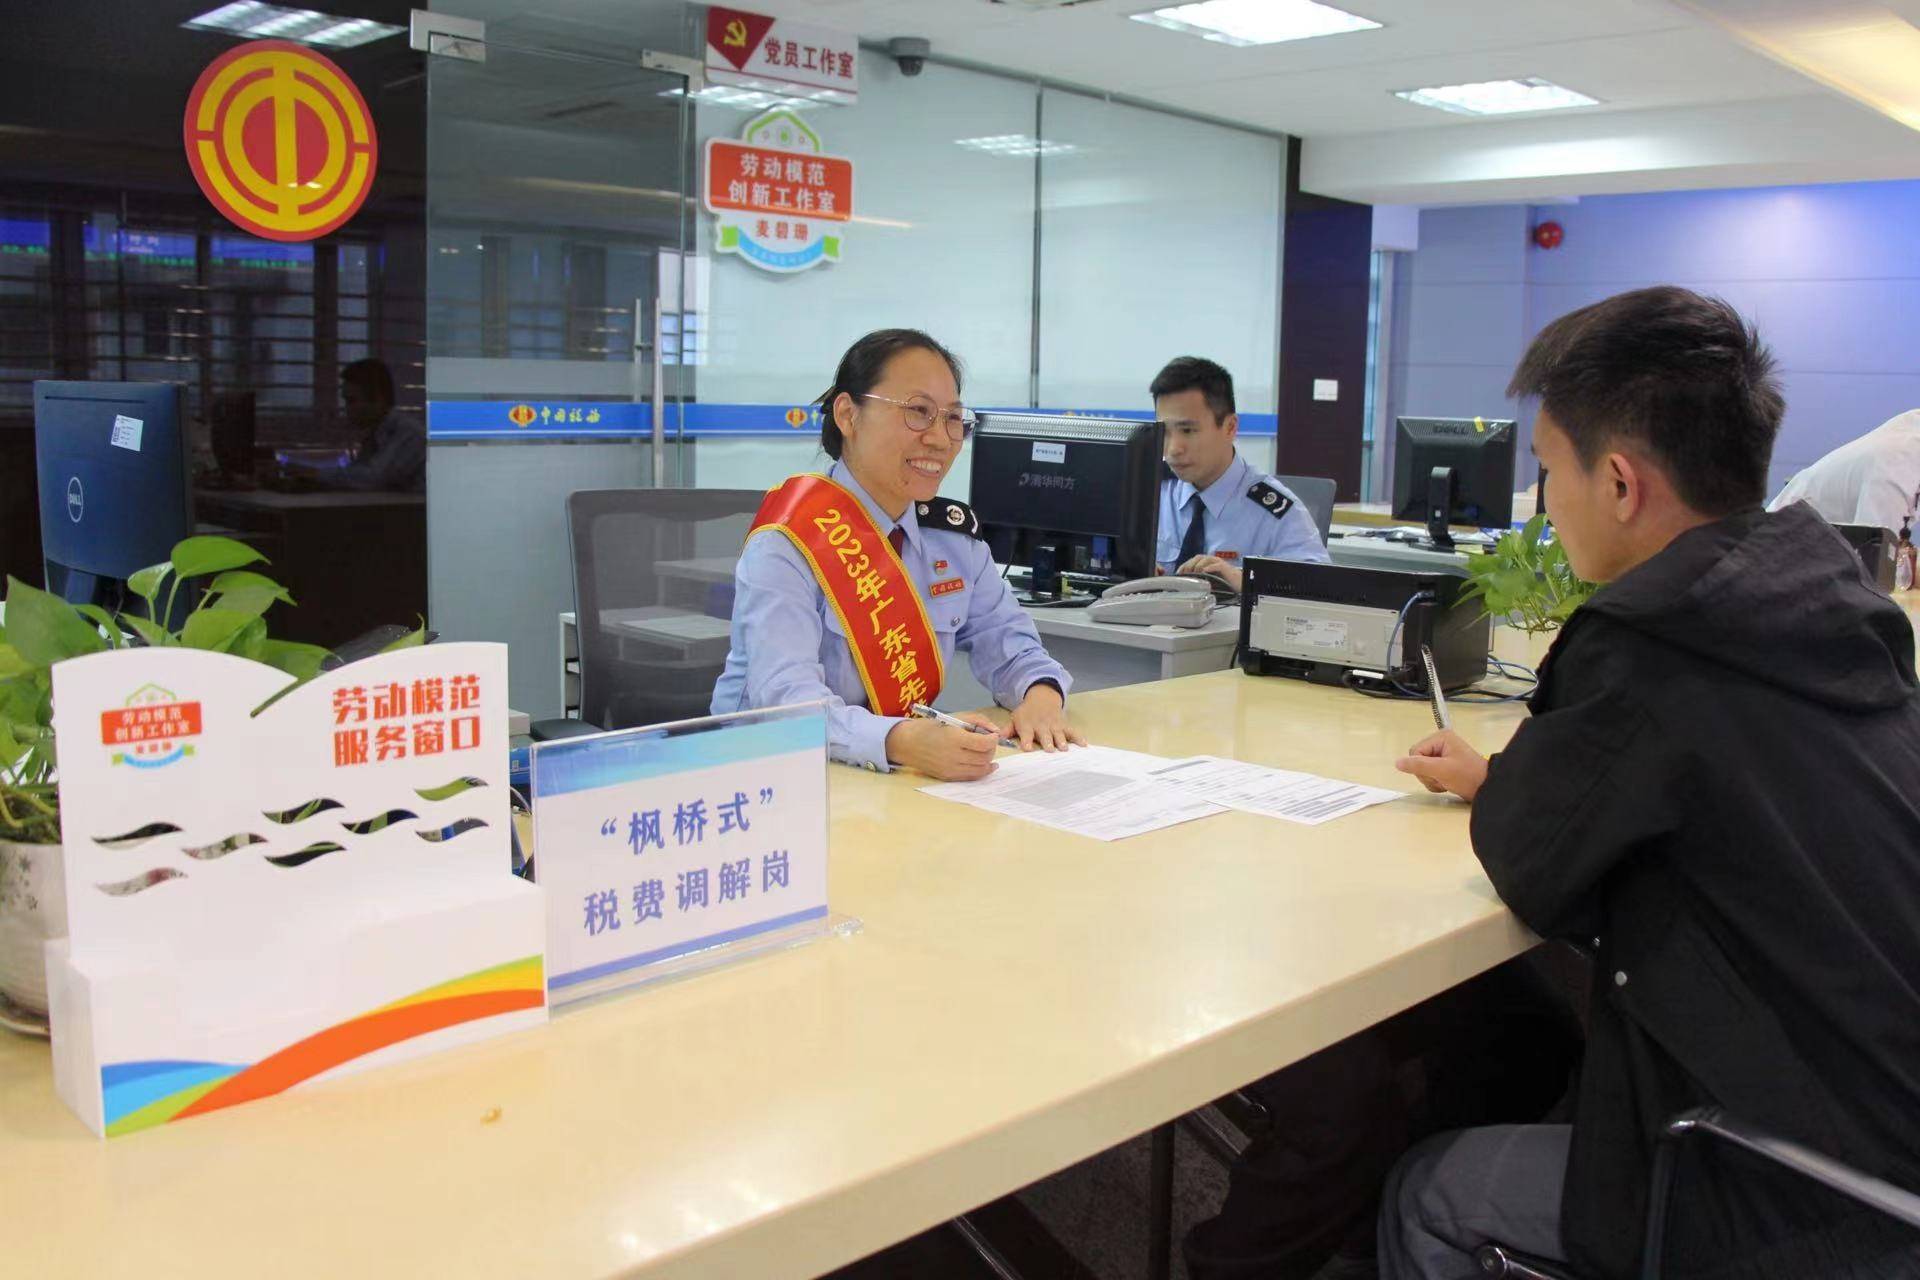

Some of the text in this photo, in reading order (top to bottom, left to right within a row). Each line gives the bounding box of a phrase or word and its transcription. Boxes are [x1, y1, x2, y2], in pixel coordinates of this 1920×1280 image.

[764, 37, 854, 79] 党员工作室
[740, 153, 825, 187] 劳动模范
[728, 179, 836, 213] 创新工作室
[332, 674, 481, 725] 劳动模范
[333, 716, 481, 768] 服务窗口
[600, 786, 774, 856] “枫桥式”
[583, 849, 790, 937] 税费调解岗
